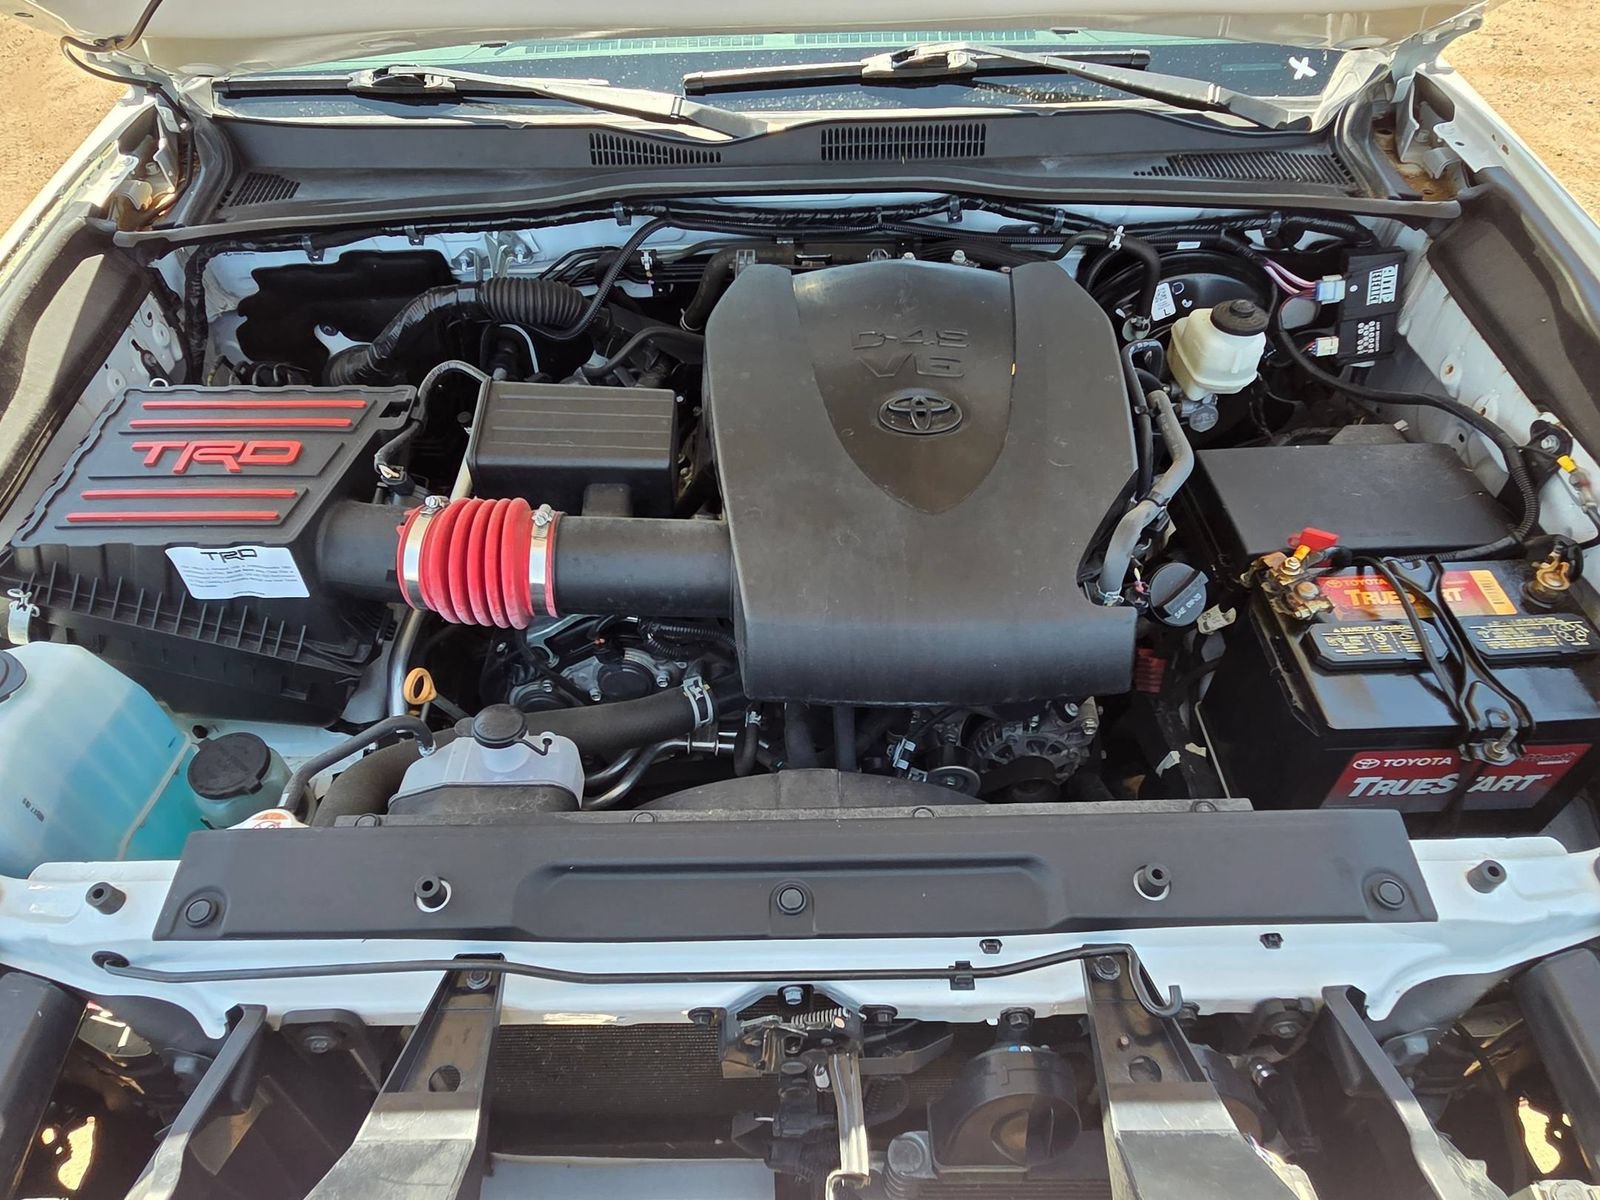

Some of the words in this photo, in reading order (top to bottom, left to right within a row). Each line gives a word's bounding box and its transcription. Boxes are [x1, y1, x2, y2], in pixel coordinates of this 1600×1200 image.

[856, 352, 966, 378] V6
[131, 440, 303, 474] TRD
[200, 548, 258, 564] TRD
[1343, 577, 1388, 586] TOYOTA
[1383, 757, 1453, 768] TOYOTA
[1348, 773, 1549, 798] TRUESART
